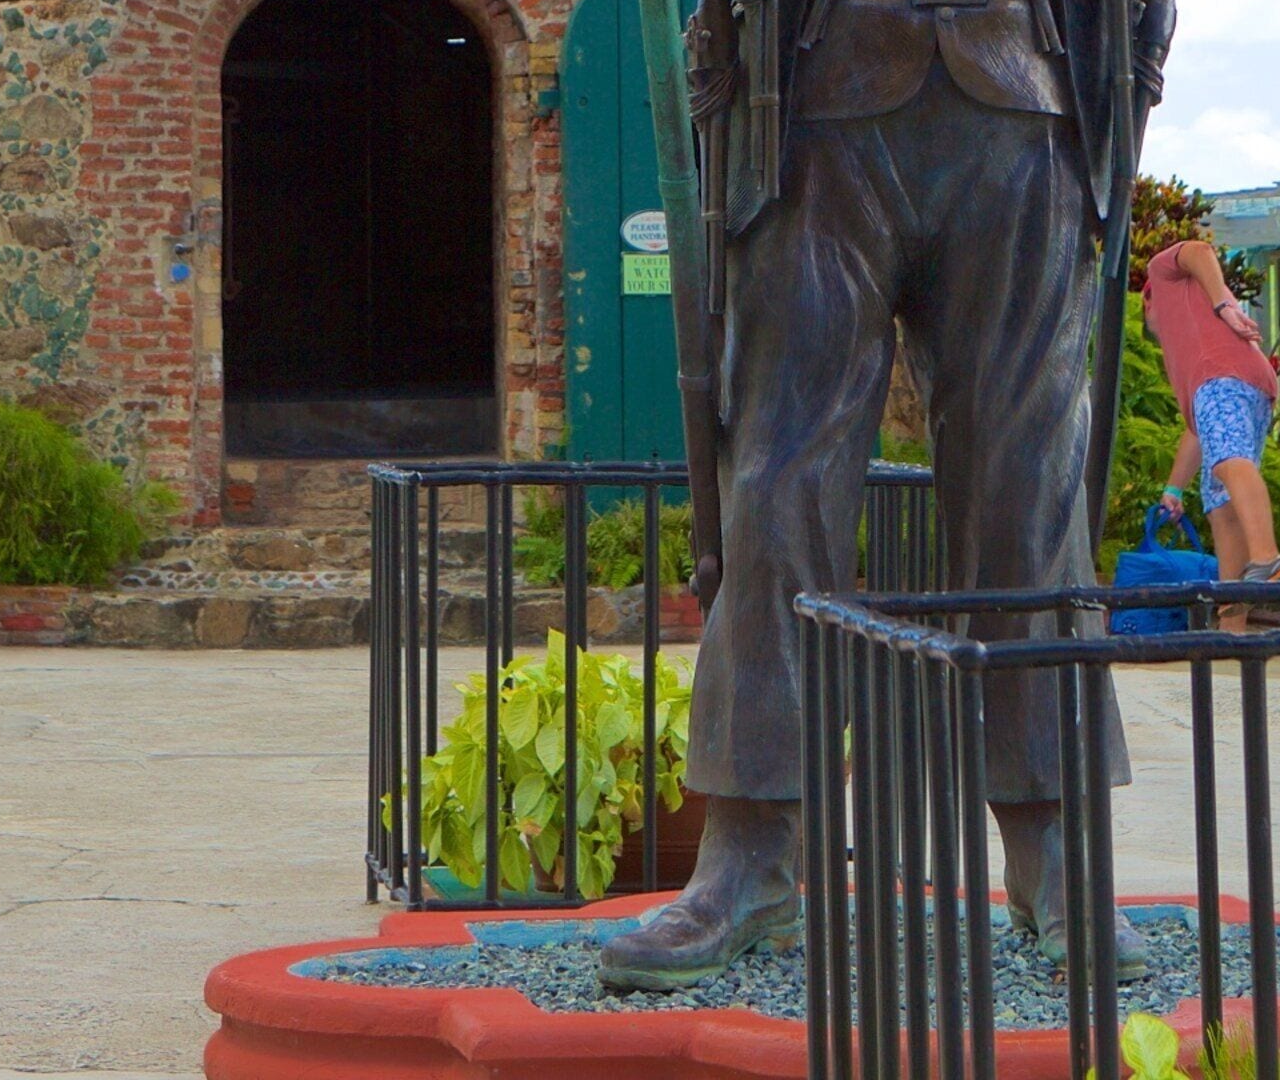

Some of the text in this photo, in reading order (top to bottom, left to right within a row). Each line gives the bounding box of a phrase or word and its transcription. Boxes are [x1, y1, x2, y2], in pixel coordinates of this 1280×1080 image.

[630, 232, 667, 241] HANDRA
[634, 267, 666, 279] WATC
[627, 280, 656, 291] YOUR
